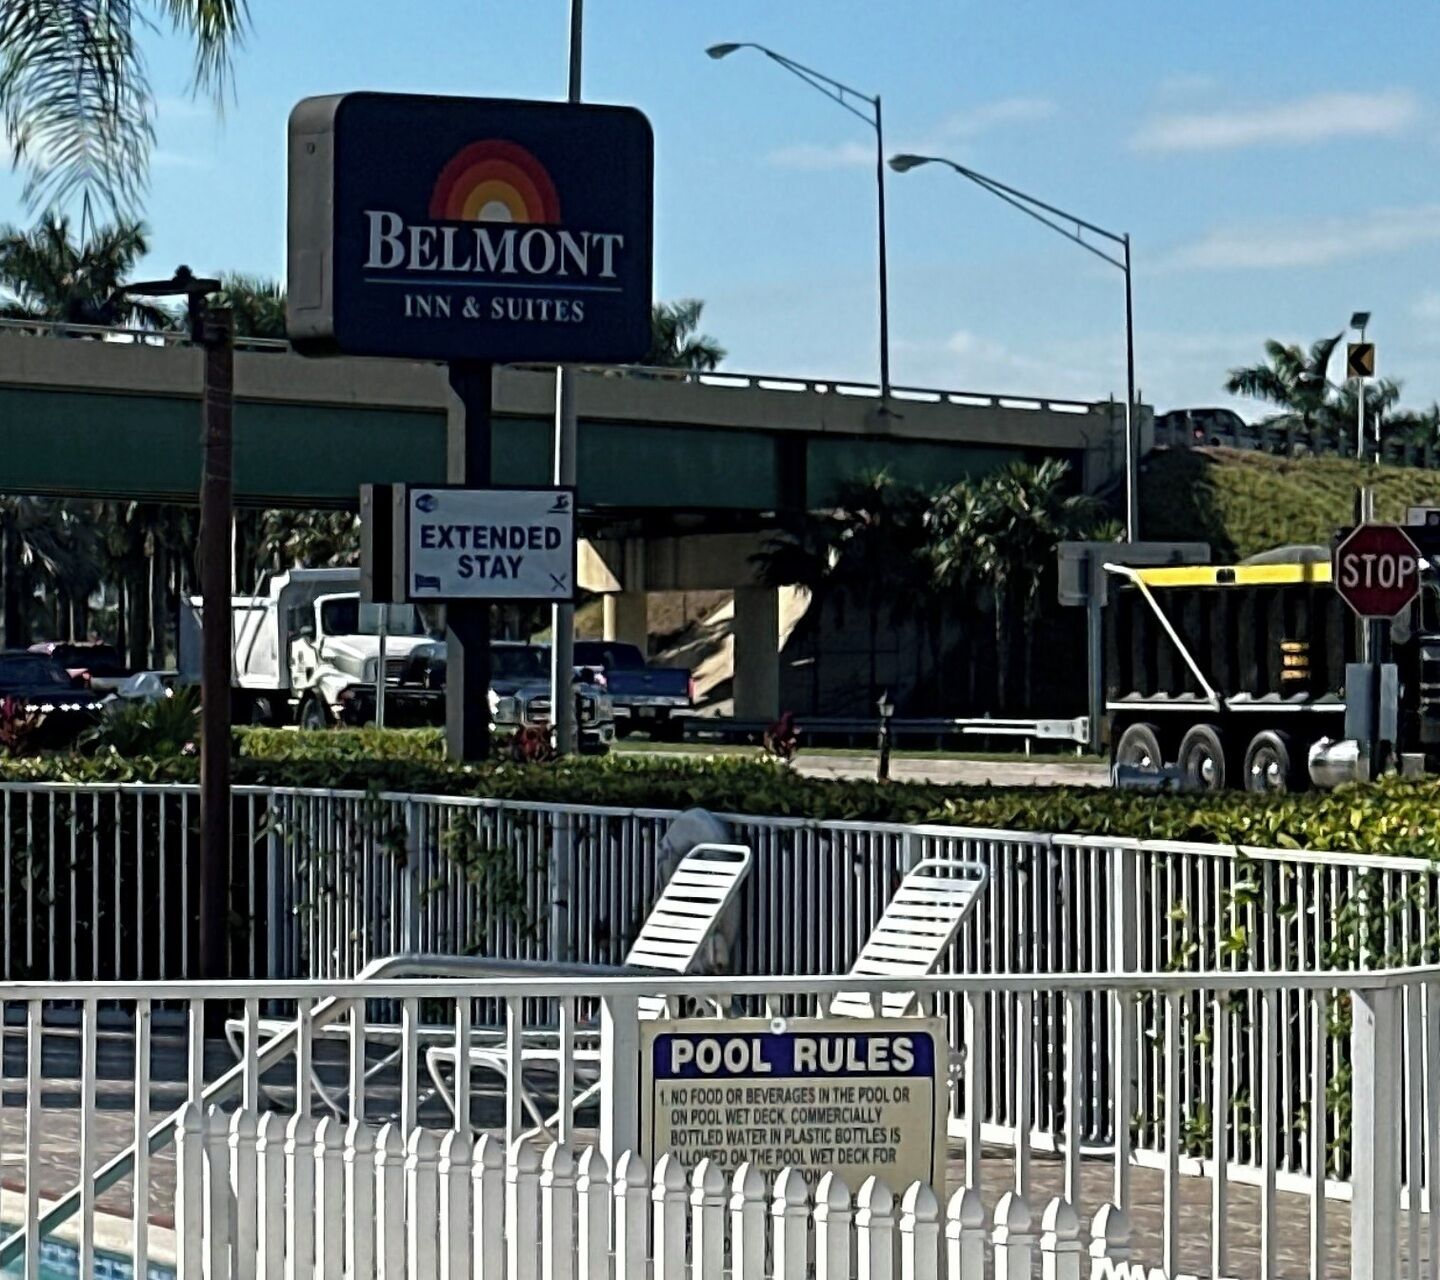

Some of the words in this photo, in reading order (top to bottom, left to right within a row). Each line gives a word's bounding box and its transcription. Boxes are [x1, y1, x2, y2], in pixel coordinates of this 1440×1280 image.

[363, 210, 624, 278] BELMONT
[404, 295, 451, 317] INN
[462, 296, 480, 318] &
[491, 298, 584, 321] SUITES
[420, 525, 560, 550] EXTENDED
[458, 554, 523, 578] STAY
[1342, 553, 1416, 589] STOP
[671, 1038, 771, 1074] POOL
[793, 1037, 915, 1072] RULES
[671, 1088, 687, 1105] NO
[691, 1088, 722, 1104] FOOD
[726, 1088, 743, 1104] OR
[746, 1087, 815, 1104] BEVERAGES
[818, 1087, 829, 1104] IN
[833, 1086, 855, 1103] THE
[859, 1086, 890, 1103] POOL
[893, 1086, 910, 1103] OR
[671, 1109, 687, 1125] ON
[691, 1109, 722, 1125] POOL
[726, 1108, 752, 1125] WET
[791, 1106, 882, 1124] COMMERCIALLY
[671, 1129, 723, 1146] BOTTLED
[726, 1129, 767, 1145] WATER
[770, 1128, 780, 1145] IN
[785, 1127, 831, 1144] PLASTIC
[836, 1127, 887, 1144] BOTTLES
[890, 1127, 901, 1144] IS
[672, 1149, 726, 1166] LLOWED
[751, 1148, 773, 1165] THE
[776, 1148, 807, 1165] POOL
[810, 1147, 836, 1164] WET
[838, 1147, 870, 1164] DECK
[873, 1147, 896, 1164] FOR
